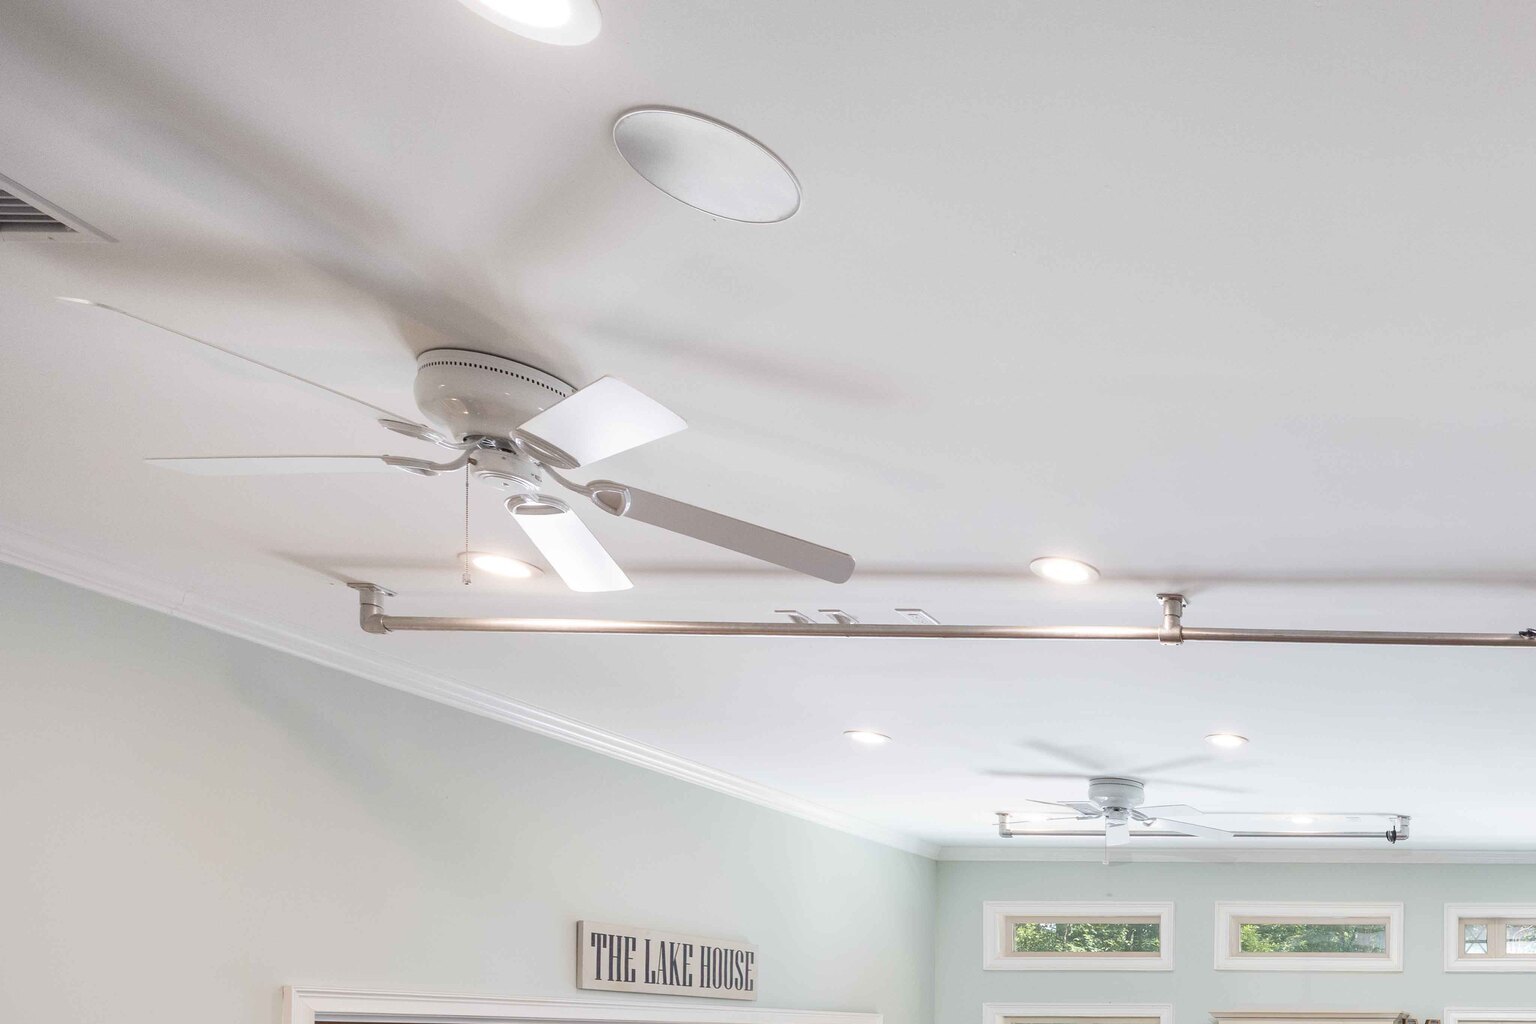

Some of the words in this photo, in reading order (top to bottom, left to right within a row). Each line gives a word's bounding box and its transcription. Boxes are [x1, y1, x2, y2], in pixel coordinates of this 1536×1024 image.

[591, 932, 638, 983] THE
[644, 939, 693, 987] LAKE
[699, 945, 755, 992] HOUSE
